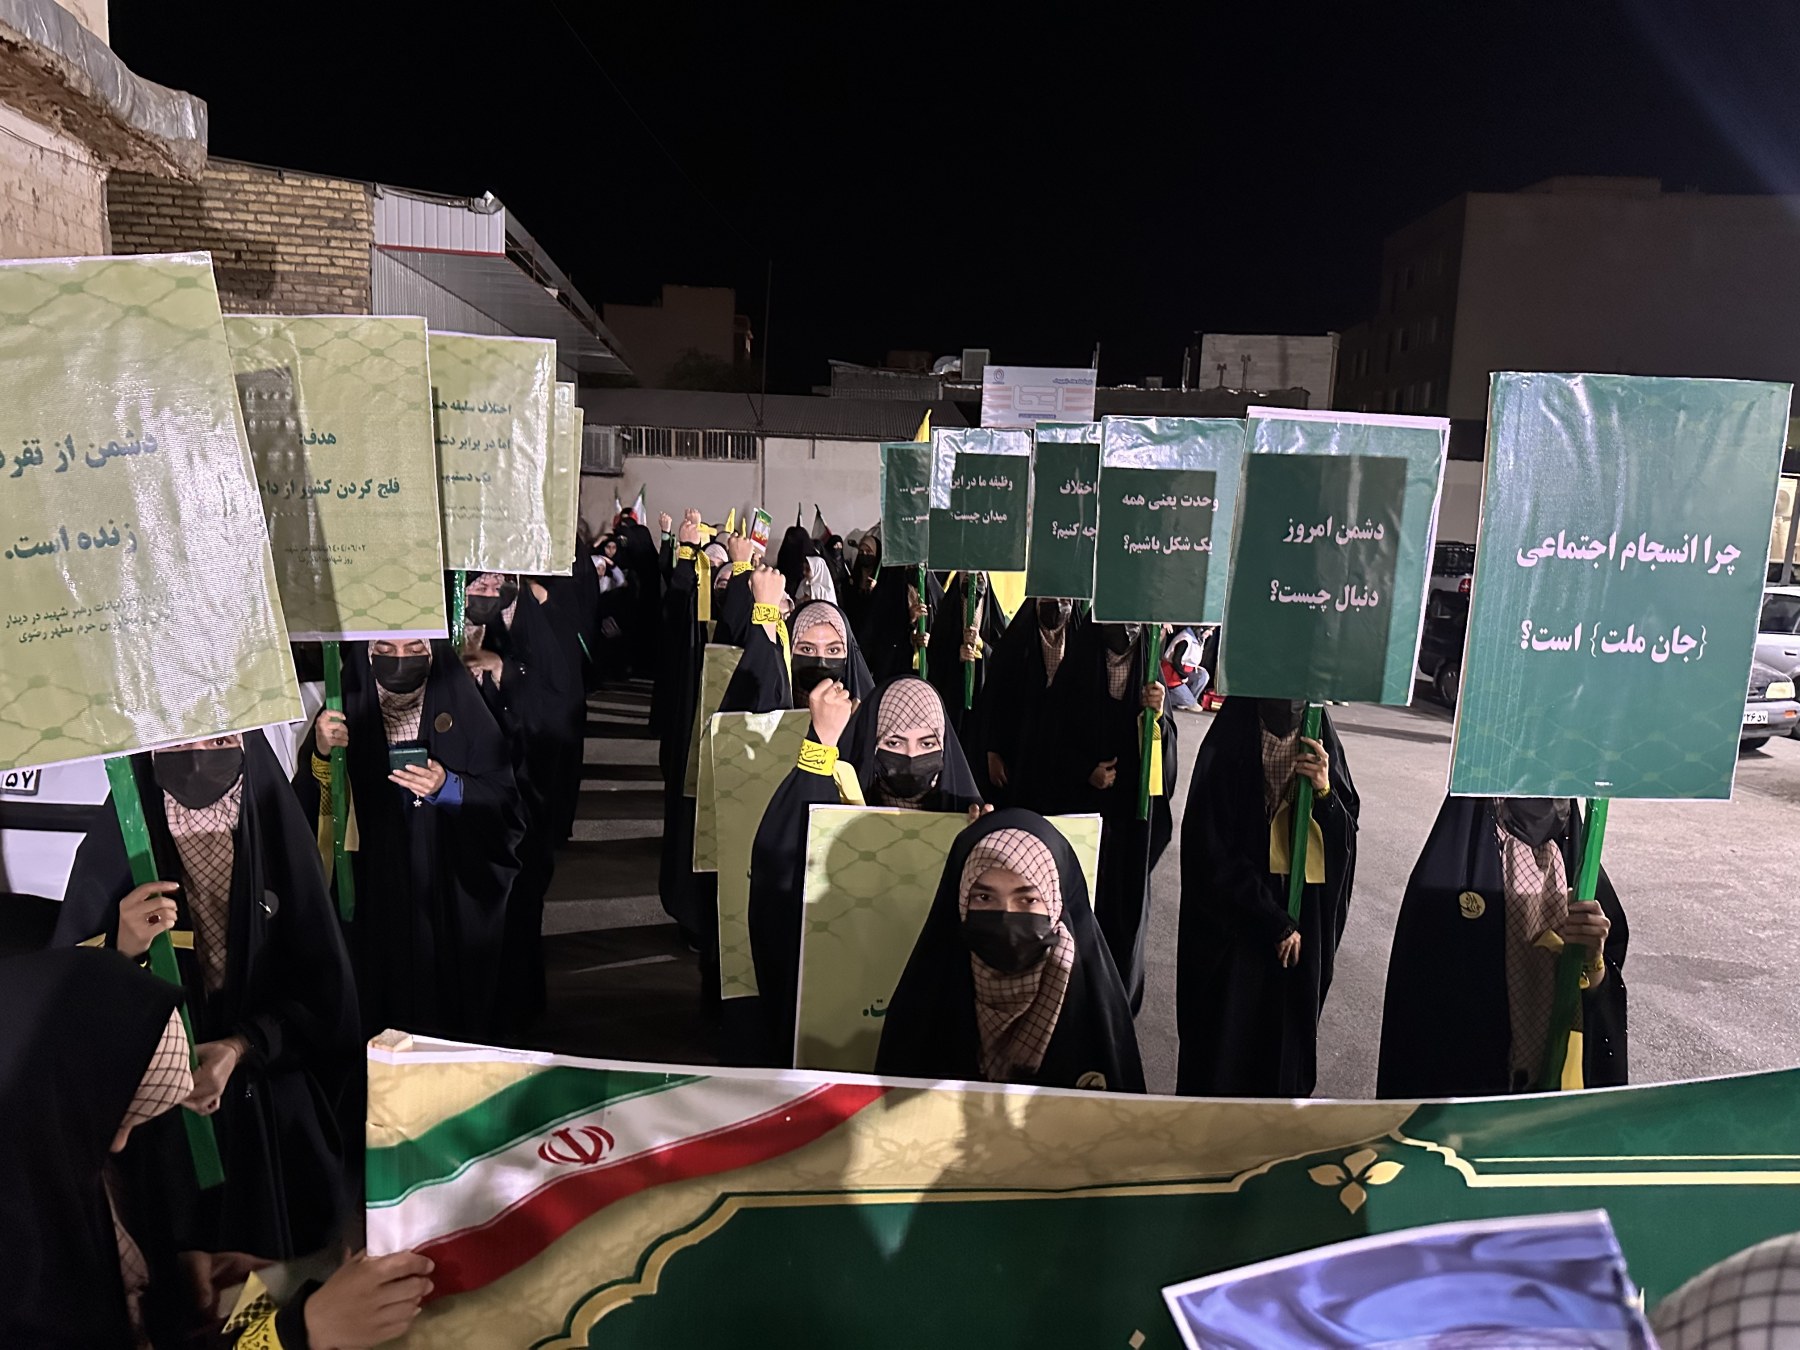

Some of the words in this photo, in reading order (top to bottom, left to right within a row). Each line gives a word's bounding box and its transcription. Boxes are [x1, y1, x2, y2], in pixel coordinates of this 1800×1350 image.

[299, 428, 337, 445] هدف:
[0, 438, 43, 478] تفر
[55, 433, 75, 472] از
[86, 430, 157, 468] دشمن
[283, 479, 295, 499] از
[300, 478, 332, 499] کشور
[337, 478, 373, 499] کردن
[377, 477, 400, 499] فلج
[949, 475, 964, 490] این
[966, 477, 976, 490] در
[979, 474, 987, 487] ما
[989, 475, 1013, 491] وظیفه
[1059, 480, 1096, 495] اختلاف
[1122, 493, 1145, 506] همه
[1148, 494, 1177, 510] یعنی
[1180, 495, 1219, 511] وحدت
[982, 509, 1008, 524] میدان
[78, 519, 137, 553] زنده
[1052, 521, 1080, 539] کنیم؟
[1282, 515, 1333, 543] امروز
[1335, 518, 1385, 545] دشمن
[5, 525, 70, 559] است.
[1123, 534, 1160, 554] باشیم؟
[1162, 536, 1190, 554] شکل
[1193, 536, 1213, 555] یک
[1516, 529, 1617, 569] اجتماعی
[1620, 532, 1698, 571] انسجام
[1704, 534, 1741, 575] چرا
[1270, 579, 1331, 612] چیست؟
[1335, 584, 1379, 612] دنبال
[5, 613, 28, 629] دیدار
[32, 613, 41, 626] در
[43, 607, 68, 622] شهید
[18, 630, 47, 644] رضوی
[50, 623, 73, 639] مطهر
[77, 623, 96, 635] حرم
[1520, 619, 1583, 651] است؟
